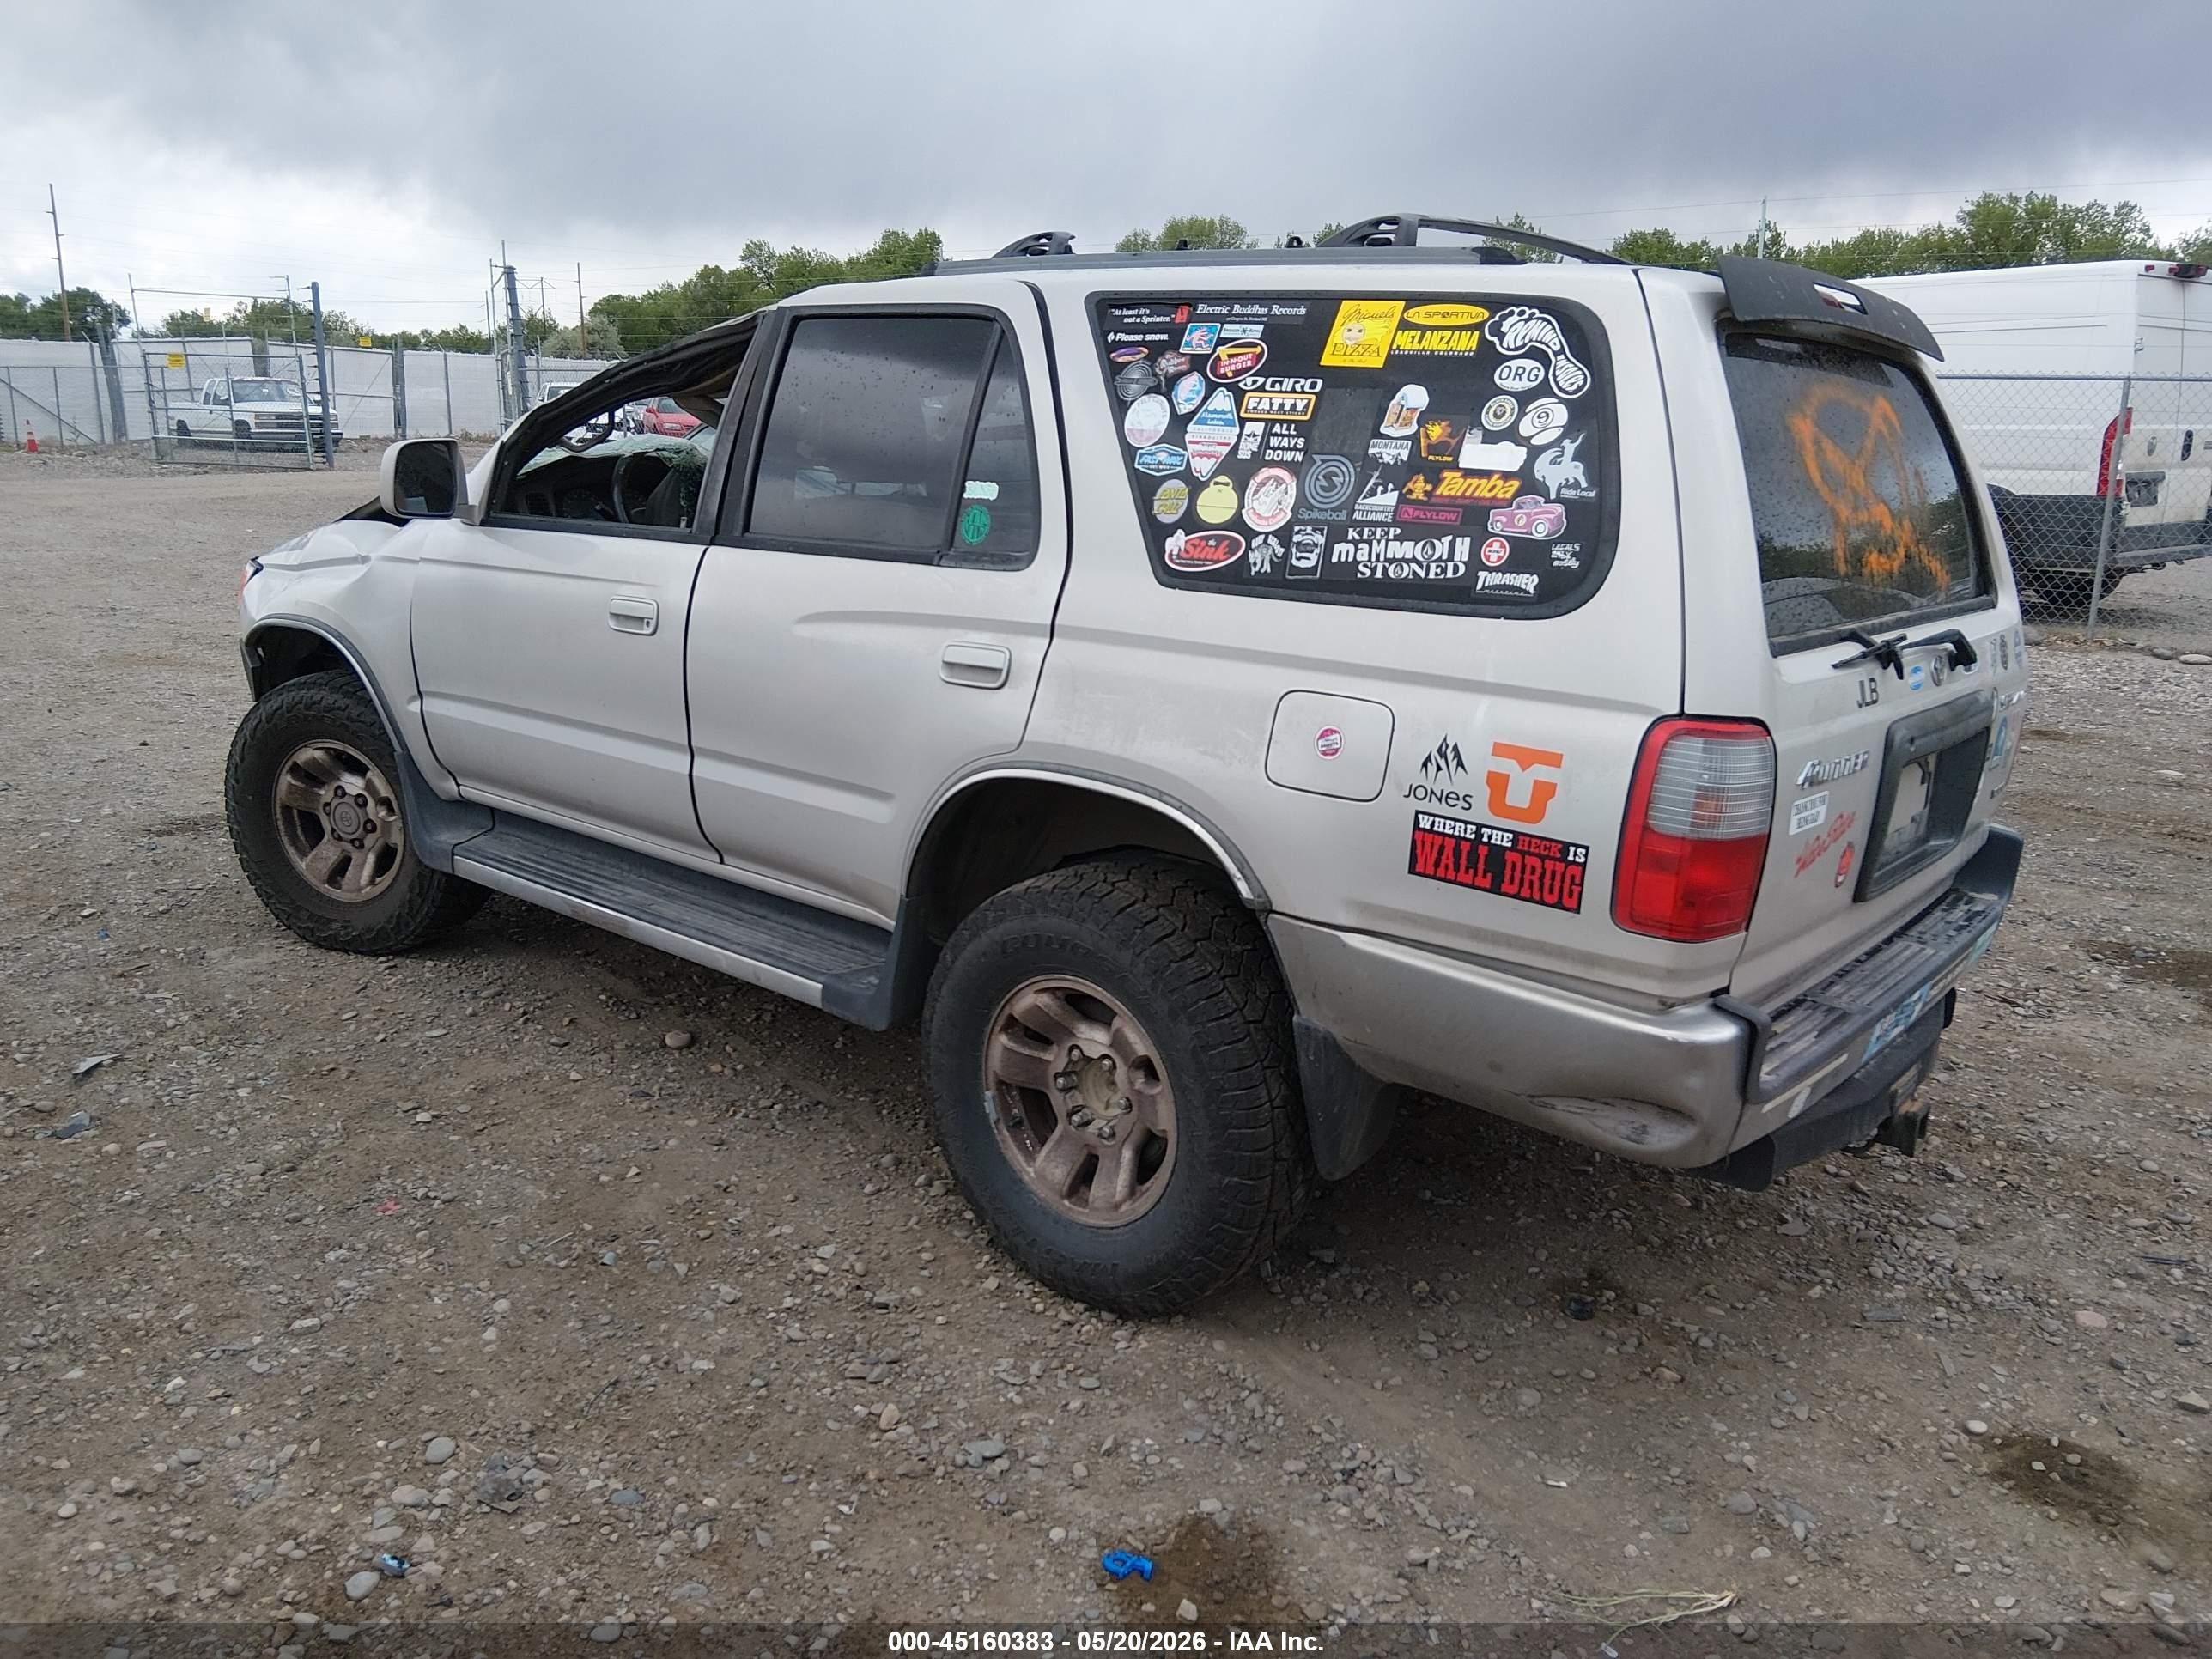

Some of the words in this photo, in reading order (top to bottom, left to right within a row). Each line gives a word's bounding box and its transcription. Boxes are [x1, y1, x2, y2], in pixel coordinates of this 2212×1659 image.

[1196, 303, 1230, 314] Electric
[1231, 304, 1268, 314] Buddhas
[1270, 305, 1307, 315] Records
[1424, 311, 1485, 319] SPORTIVA
[1115, 332, 1144, 342] Please
[1392, 330, 1480, 351] MELANZANA
[1329, 343, 1382, 357] PIZZA
[1220, 353, 1254, 367] IN-N-OUT
[1220, 360, 1253, 374] BURGER
[1498, 365, 1541, 382] ORG
[1265, 377, 1323, 392] GIRO
[1247, 397, 1309, 411] FATTY
[1272, 422, 1297, 434] ALL
[1270, 436, 1306, 448] WAYS
[1370, 440, 1410, 451] MONTANA
[1264, 449, 1305, 462] DOWN
[1435, 469, 1522, 500] Tamba
[1560, 487, 1577, 495] Ride
[1577, 489, 1596, 497] Local
[1297, 507, 1347, 520] Spikeball
[1352, 510, 1395, 523] ALLIANCE
[1413, 510, 1458, 521] FLYLOW
[1346, 526, 1402, 540] KEEP
[1357, 562, 1467, 580] STONED
[1476, 570, 1539, 594] THRASHER
[1418, 813, 1476, 841] WHERE
[1480, 827, 1514, 848] THE
[1516, 835, 1564, 858] HECK
[1567, 845, 1587, 864] IS
[1414, 830, 1493, 890] WALL
[1501, 850, 1583, 908] DRUG
